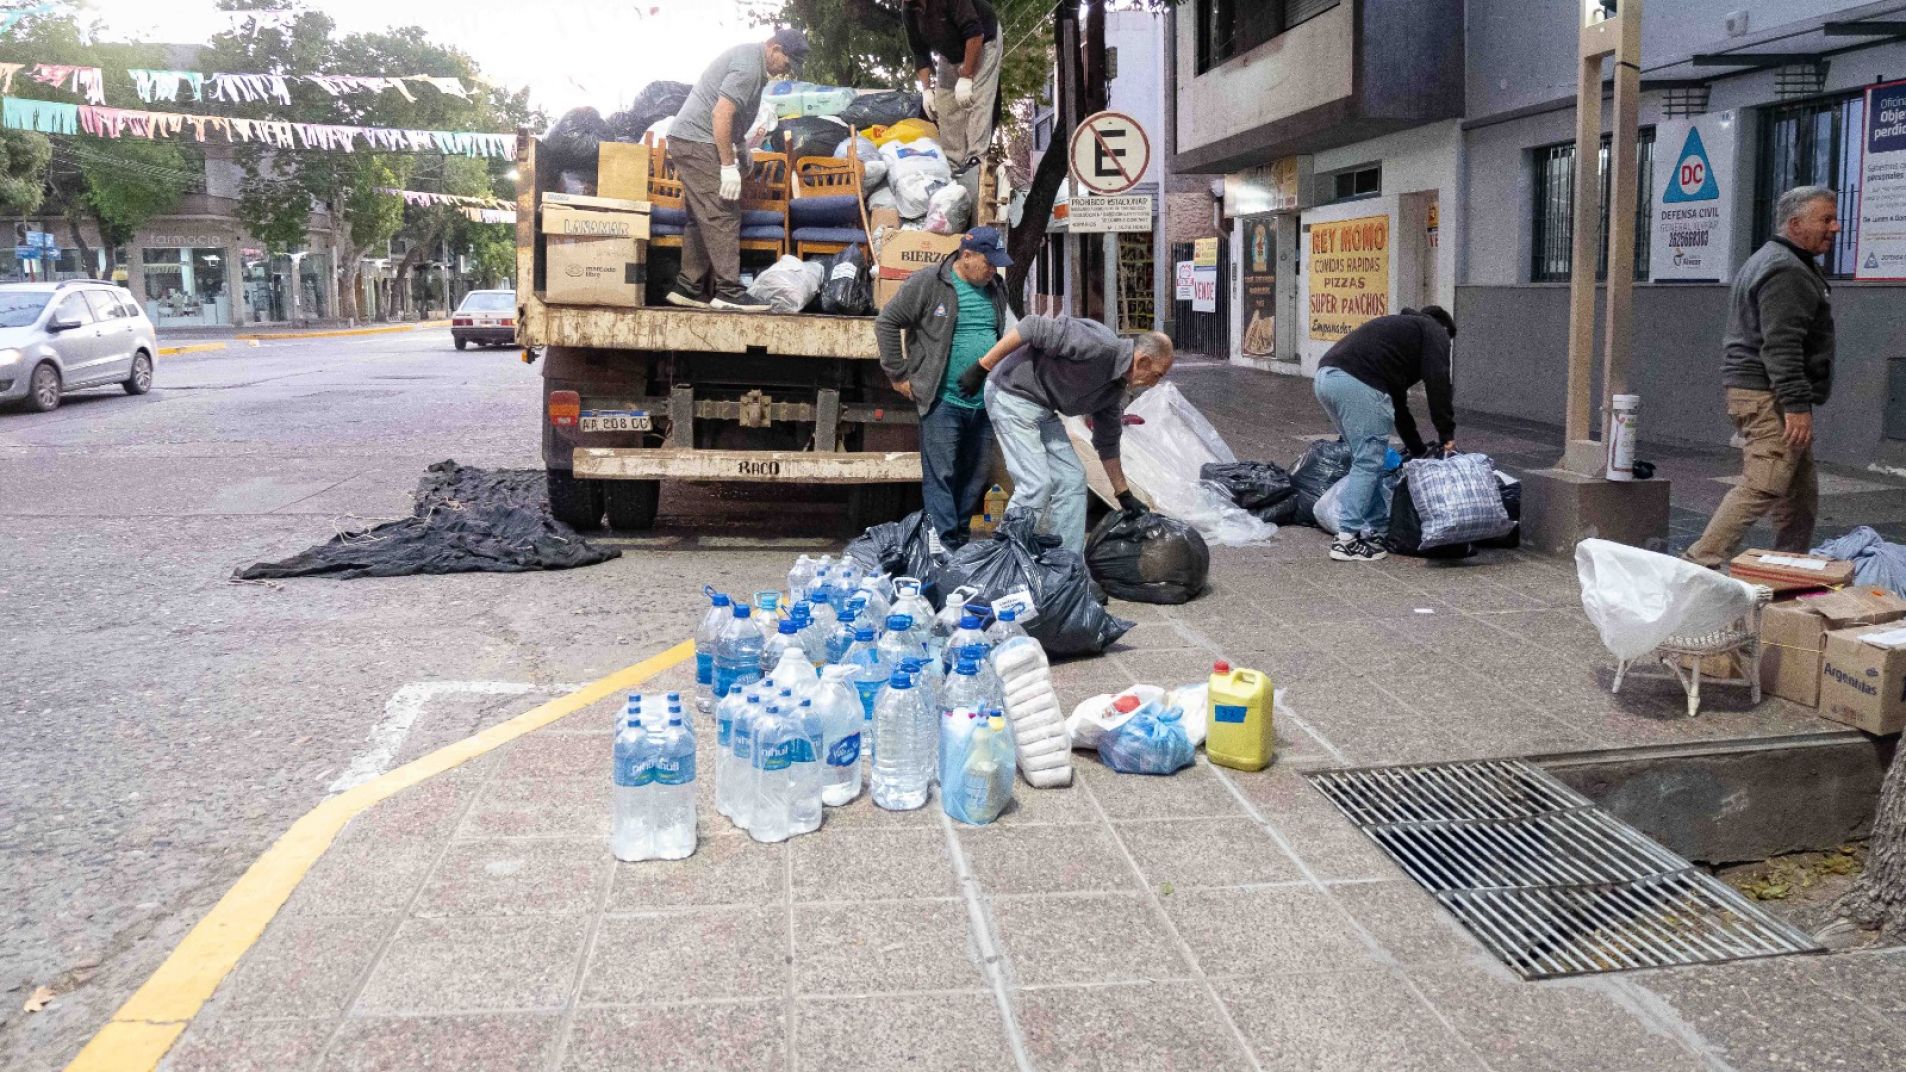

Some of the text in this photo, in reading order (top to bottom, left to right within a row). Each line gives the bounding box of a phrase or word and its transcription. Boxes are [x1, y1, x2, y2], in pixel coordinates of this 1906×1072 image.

[1880, 108, 1906, 124] Obje
[1095, 130, 1126, 177] E
[1681, 164, 1703, 185] DC
[1661, 207, 1719, 220] DEFENSA CIVIL
[1312, 222, 1385, 254] REY MOMO
[1314, 257, 1381, 273] COMIDAS RAPIDAS
[1194, 281, 1215, 301] VENDE
[1324, 278, 1366, 289] PIZZAS
[1311, 293, 1386, 316] SUPER PANCHOS
[738, 461, 780, 476] RACO
